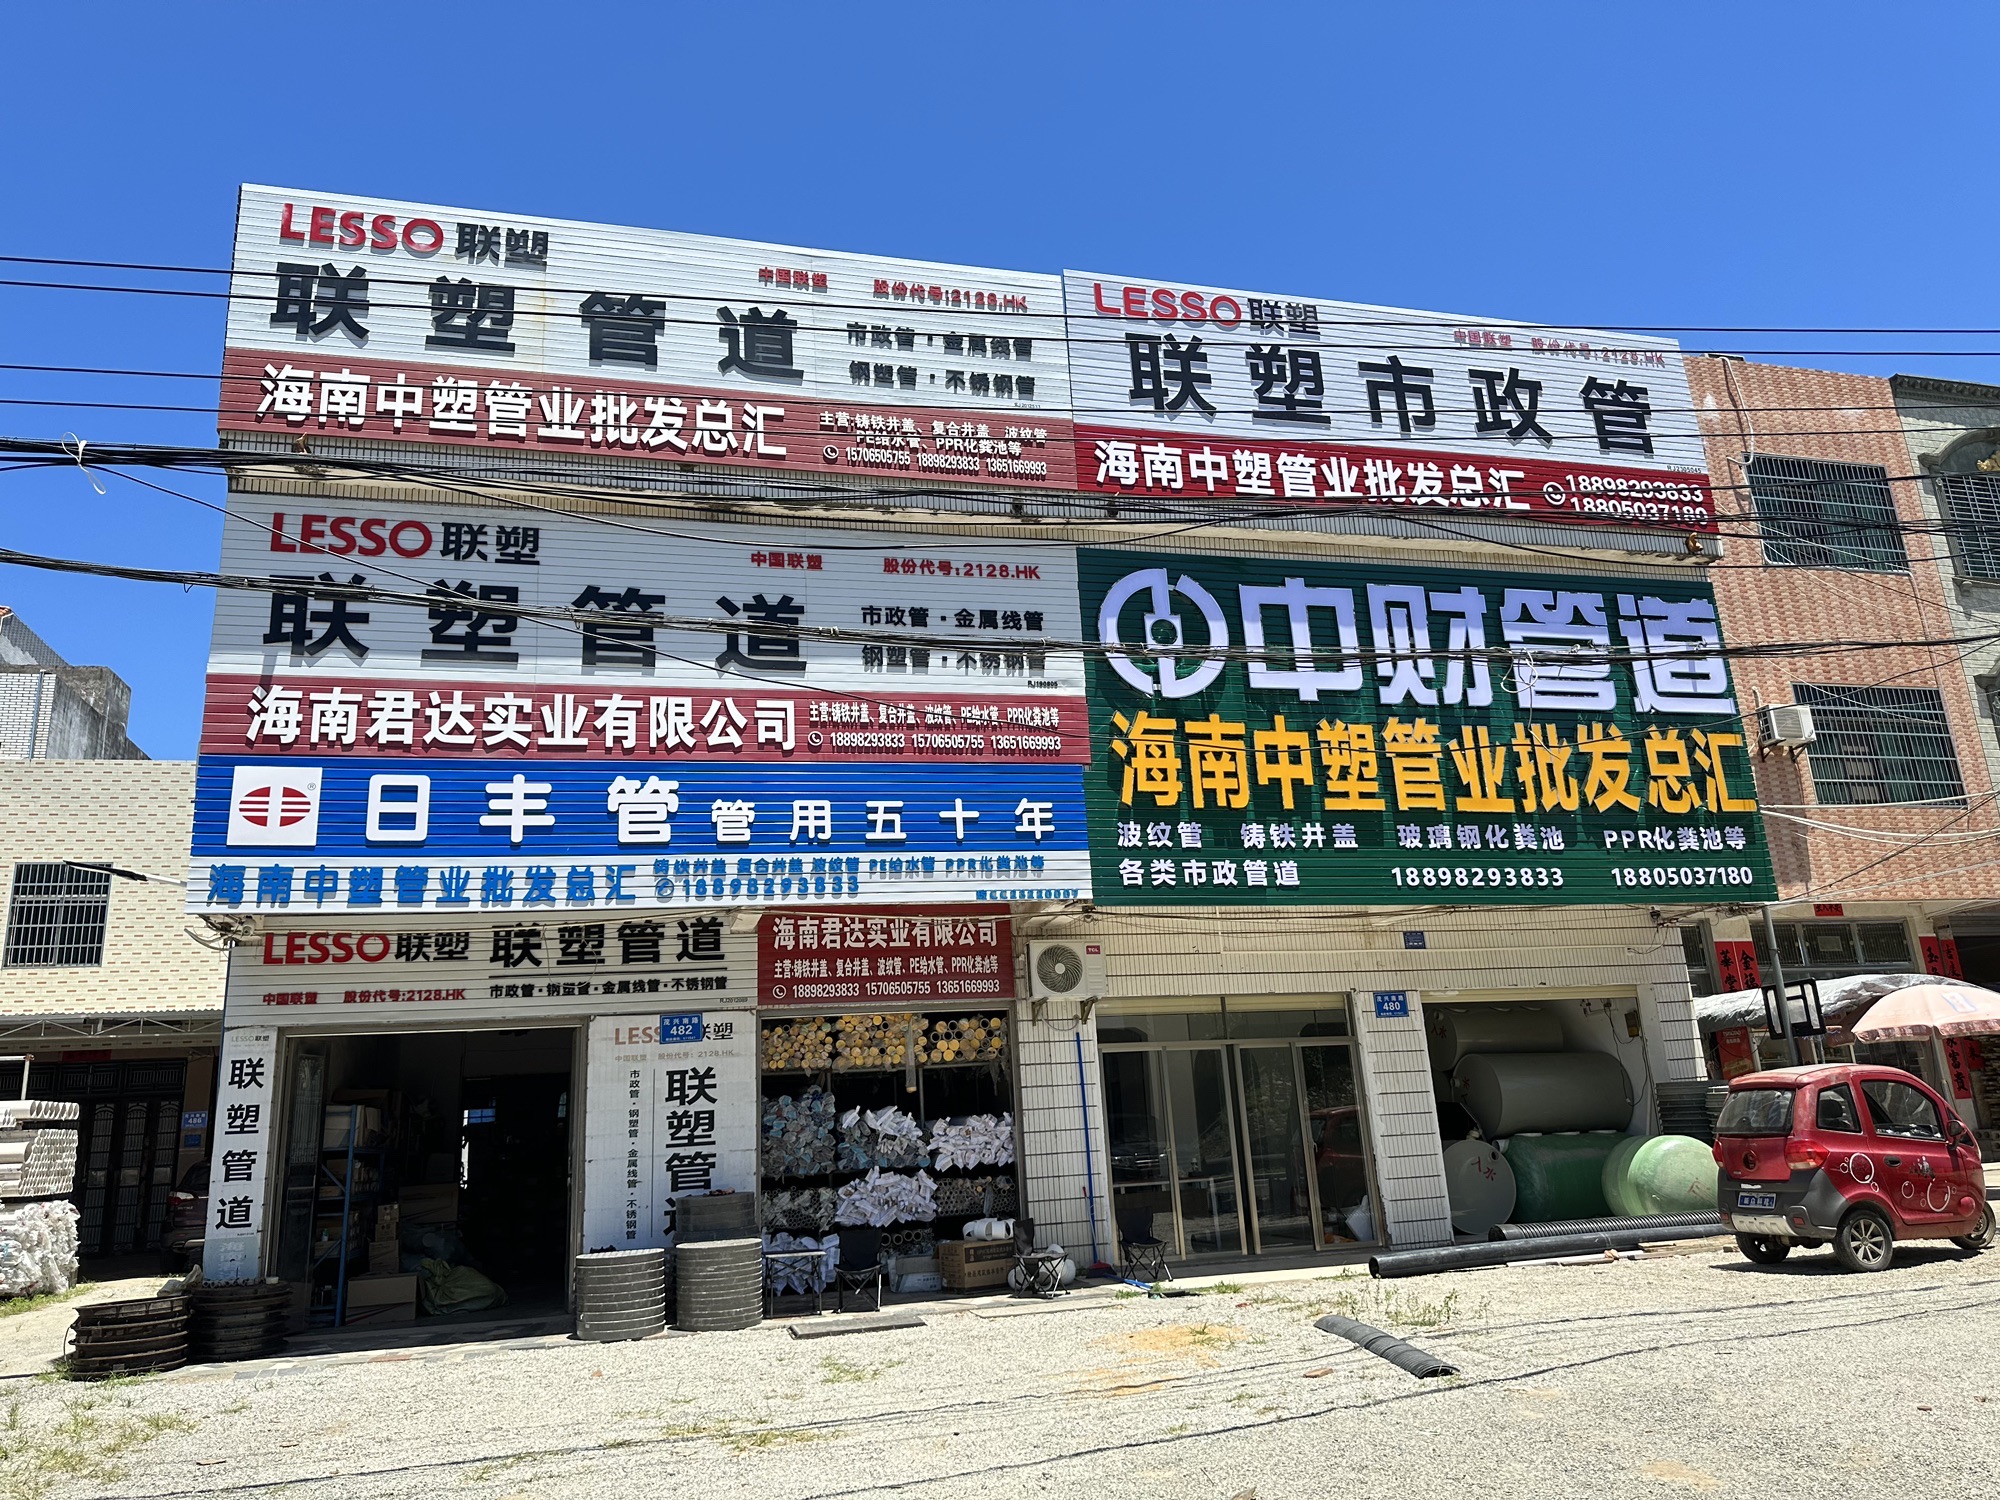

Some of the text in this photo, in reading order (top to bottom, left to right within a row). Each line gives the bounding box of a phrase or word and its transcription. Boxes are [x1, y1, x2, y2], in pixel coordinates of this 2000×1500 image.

[280, 203, 549, 265] LESSO 联塑
[758, 266, 828, 291] 中国联塑
[270, 261, 804, 379] 联塑管道
[1093, 282, 1321, 336] LESSO 联塑
[1454, 328, 1512, 347] 中国联塑
[256, 363, 787, 456] 海南中塑管业批发总汇
[1125, 332, 1654, 454] 联塑市政管
[846, 446, 1047, 476] 15706505755 18898293833 13651669993
[1094, 440, 1531, 510] 海南中塑管业批发总汇
[1565, 474, 1704, 502] 18898293833
[269, 512, 540, 566] LESSO 联塑
[750, 550, 1041, 580] 中国联塑 股份代号:2128.HK
[262, 571, 807, 671] 联塑管道
[1238, 577, 1737, 715] 中财管道
[246, 684, 796, 751] 海南君达实业有限公司
[830, 731, 1061, 751] 18898293833 15706505755 13651669993
[1110, 709, 1758, 814] 海南中塑管业批发总汇
[365, 773, 1056, 845] 日丰管 管用五十年
[1117, 822, 1747, 852] 波纹管 铸铁井盖 玻璃钢化粪池 PPR化粪池等
[207, 855, 1046, 905] 海南中塑管业批发总汇 铸铁井盖 复合井盖 波纹管 PE给水管 PPR化粪池等
[682, 875, 860, 898] 18898293833
[1119, 858, 1753, 888] 各类市政管道 18898293833 18805037180
[262, 931, 469, 965] LESSO 联塑
[489, 916, 726, 968] 联塑管道
[773, 915, 998, 951] 海南君达实业有限公司
[262, 991, 318, 1006] 中国联塑
[792, 979, 1000, 998] 18898293833 15706505755 13651669993
[1383, 1001, 1401, 1011] 480
[670, 1024, 693, 1036] 482
[615, 1053, 648, 1062] 中国联塑
[215, 1057, 265, 1230] 联塑管道
